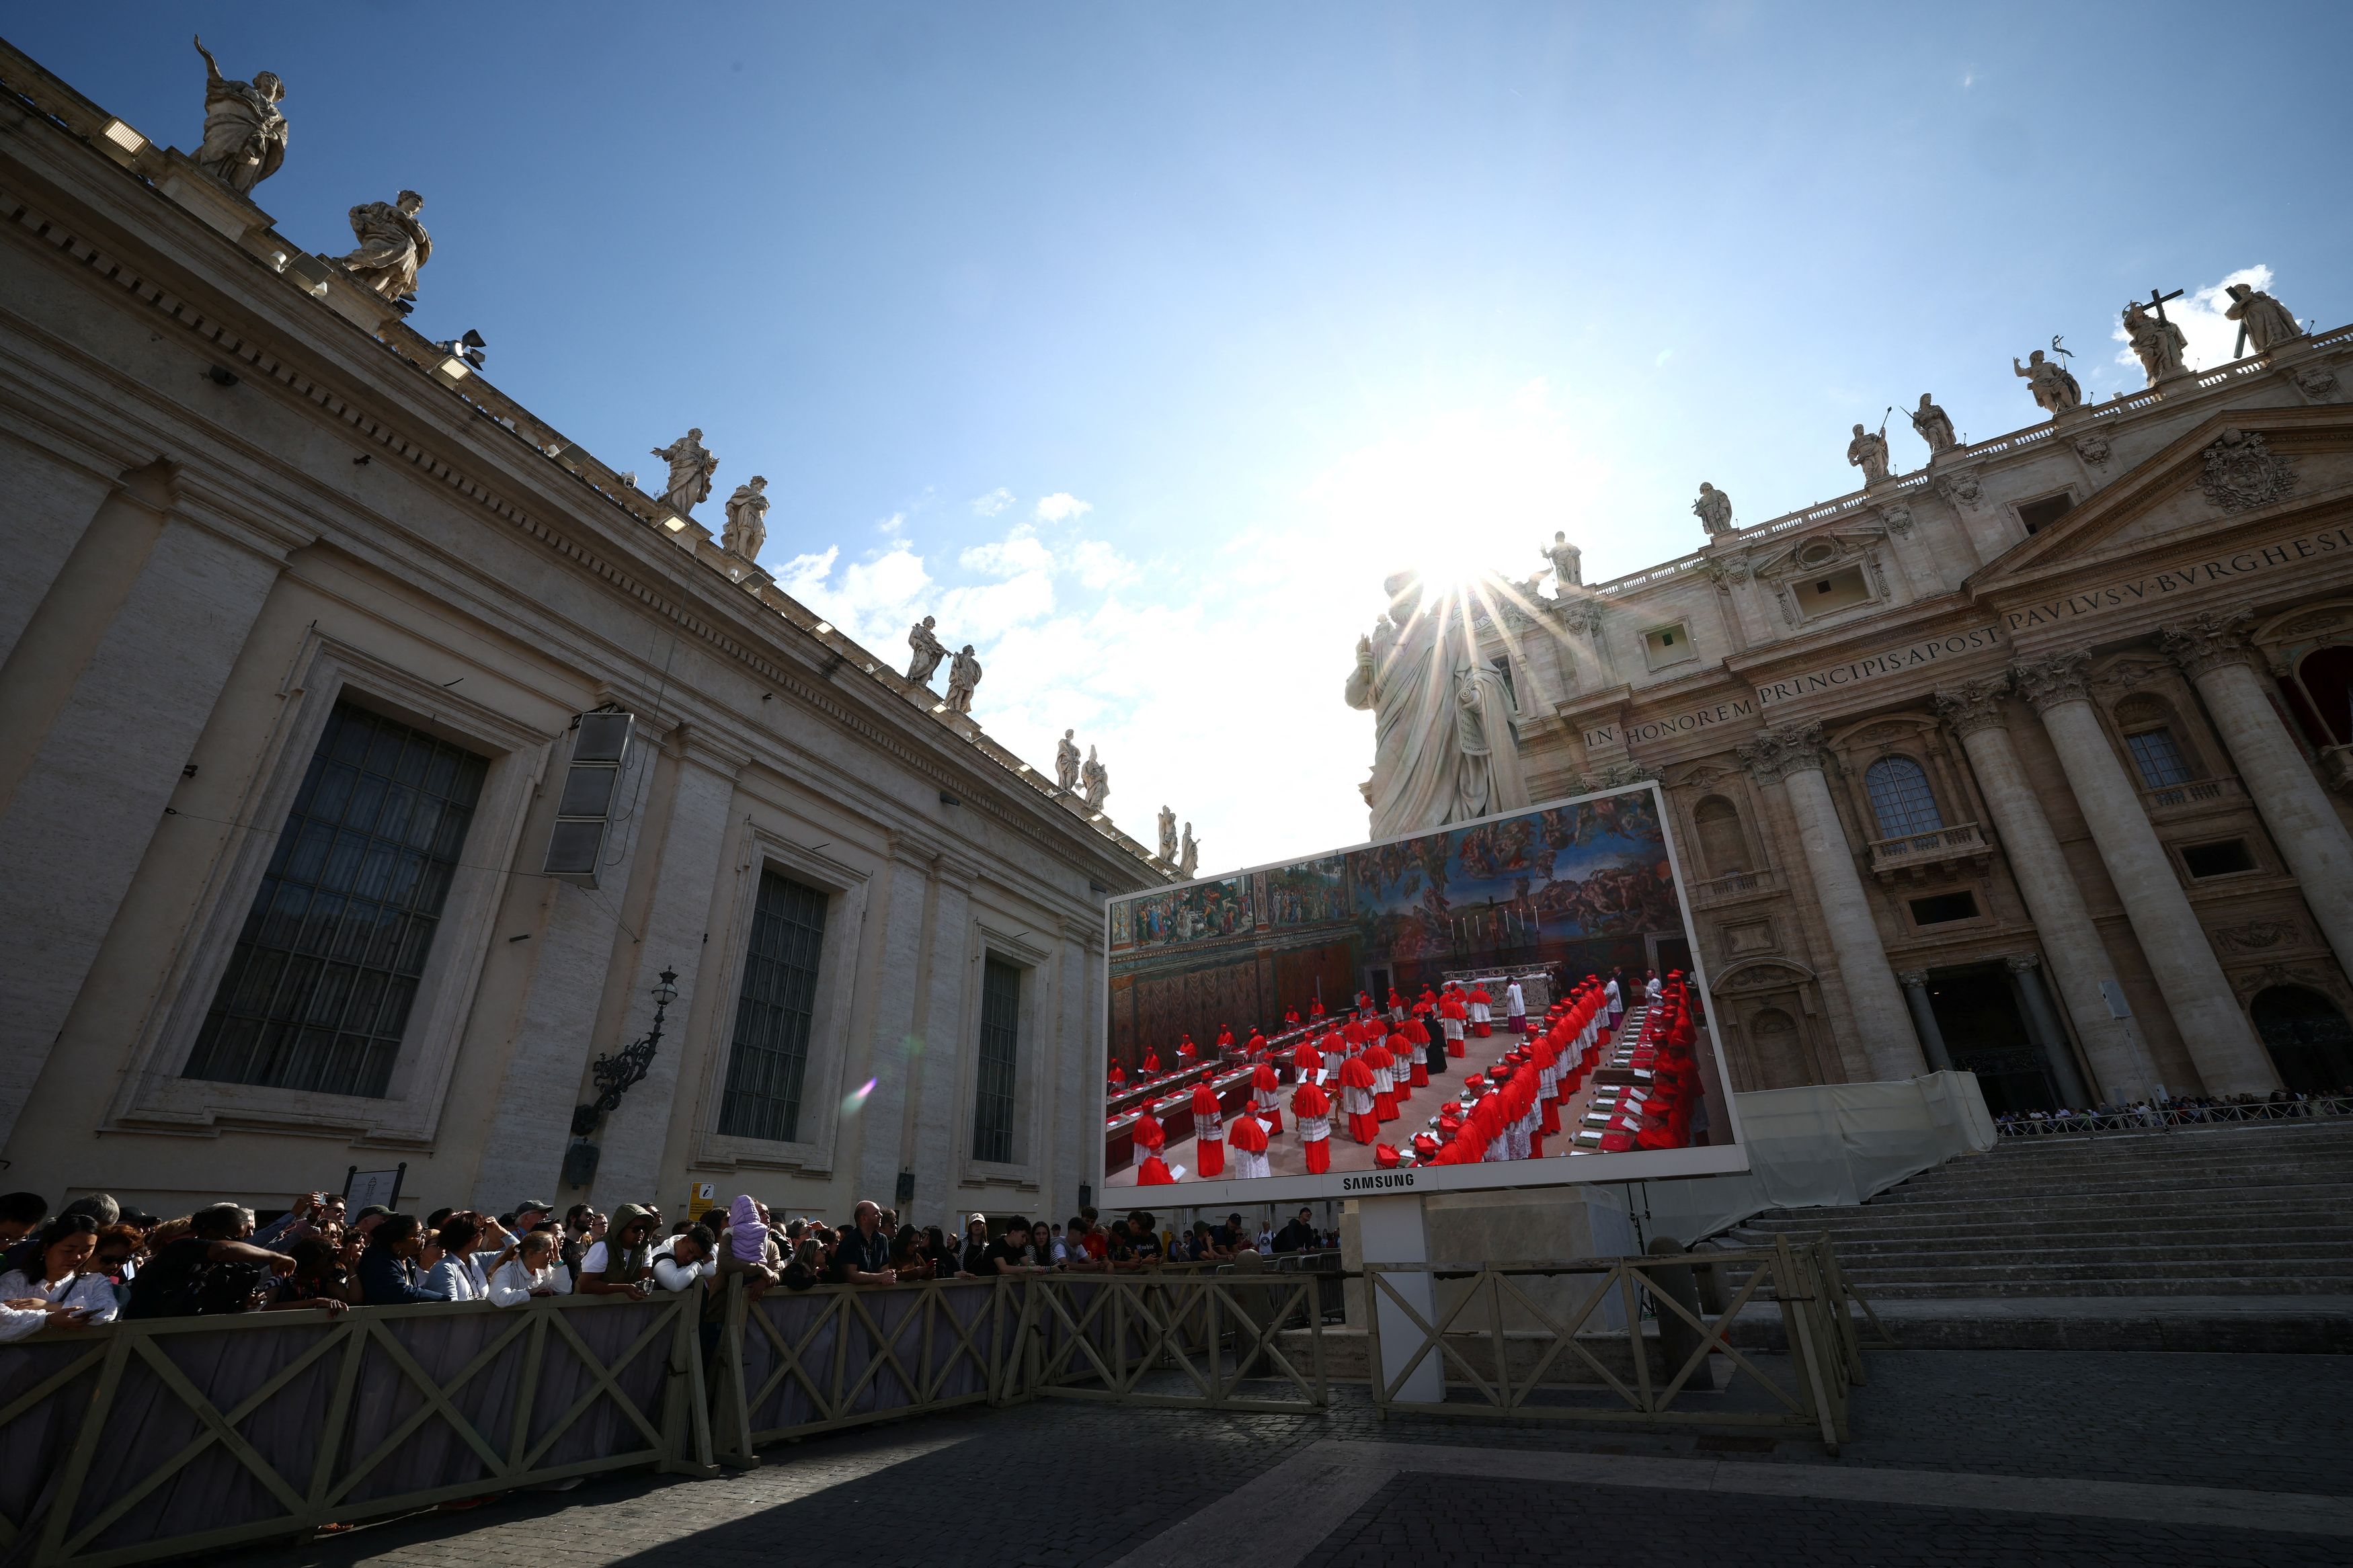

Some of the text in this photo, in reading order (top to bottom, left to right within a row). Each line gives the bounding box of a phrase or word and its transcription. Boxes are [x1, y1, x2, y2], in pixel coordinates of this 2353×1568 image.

[1587, 526, 2353, 747] IN HONOREM PRINCIPIS APOST PAVLVS V BVRGHESI
[1343, 1173, 1414, 1190] SAMSUNG
